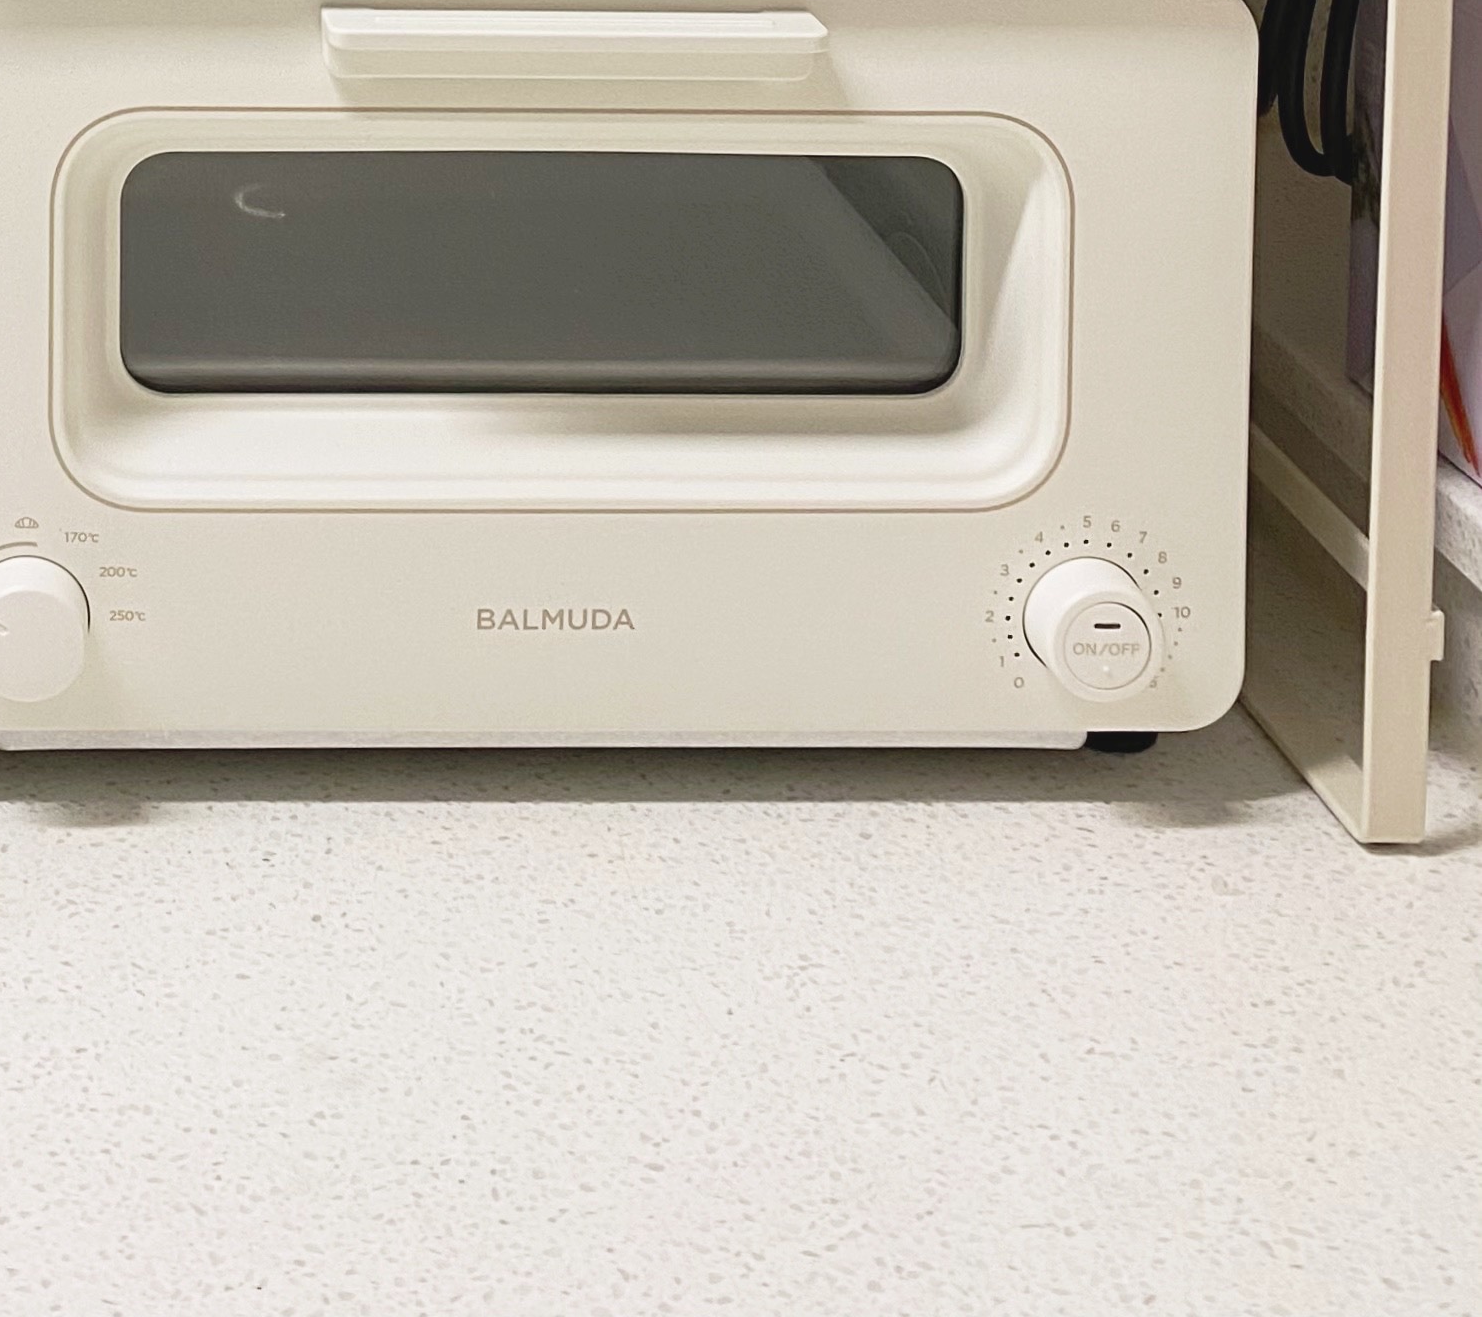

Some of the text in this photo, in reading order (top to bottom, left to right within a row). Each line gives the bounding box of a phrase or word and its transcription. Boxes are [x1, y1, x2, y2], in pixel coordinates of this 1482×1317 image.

[1082, 515, 1092, 528] 5
[1110, 520, 1121, 533] 6
[1034, 531, 1044, 544] 4
[1138, 531, 1148, 544] 7
[1158, 551, 1168, 564] 8
[1000, 564, 1010, 577] 3
[1172, 576, 1182, 589] 9
[985, 610, 995, 623] 2
[1174, 606, 1191, 619] 10
[476, 608, 636, 631] BALMUDA
[1072, 642, 1141, 657] ON/OFF
[999, 655, 1005, 667] 1
